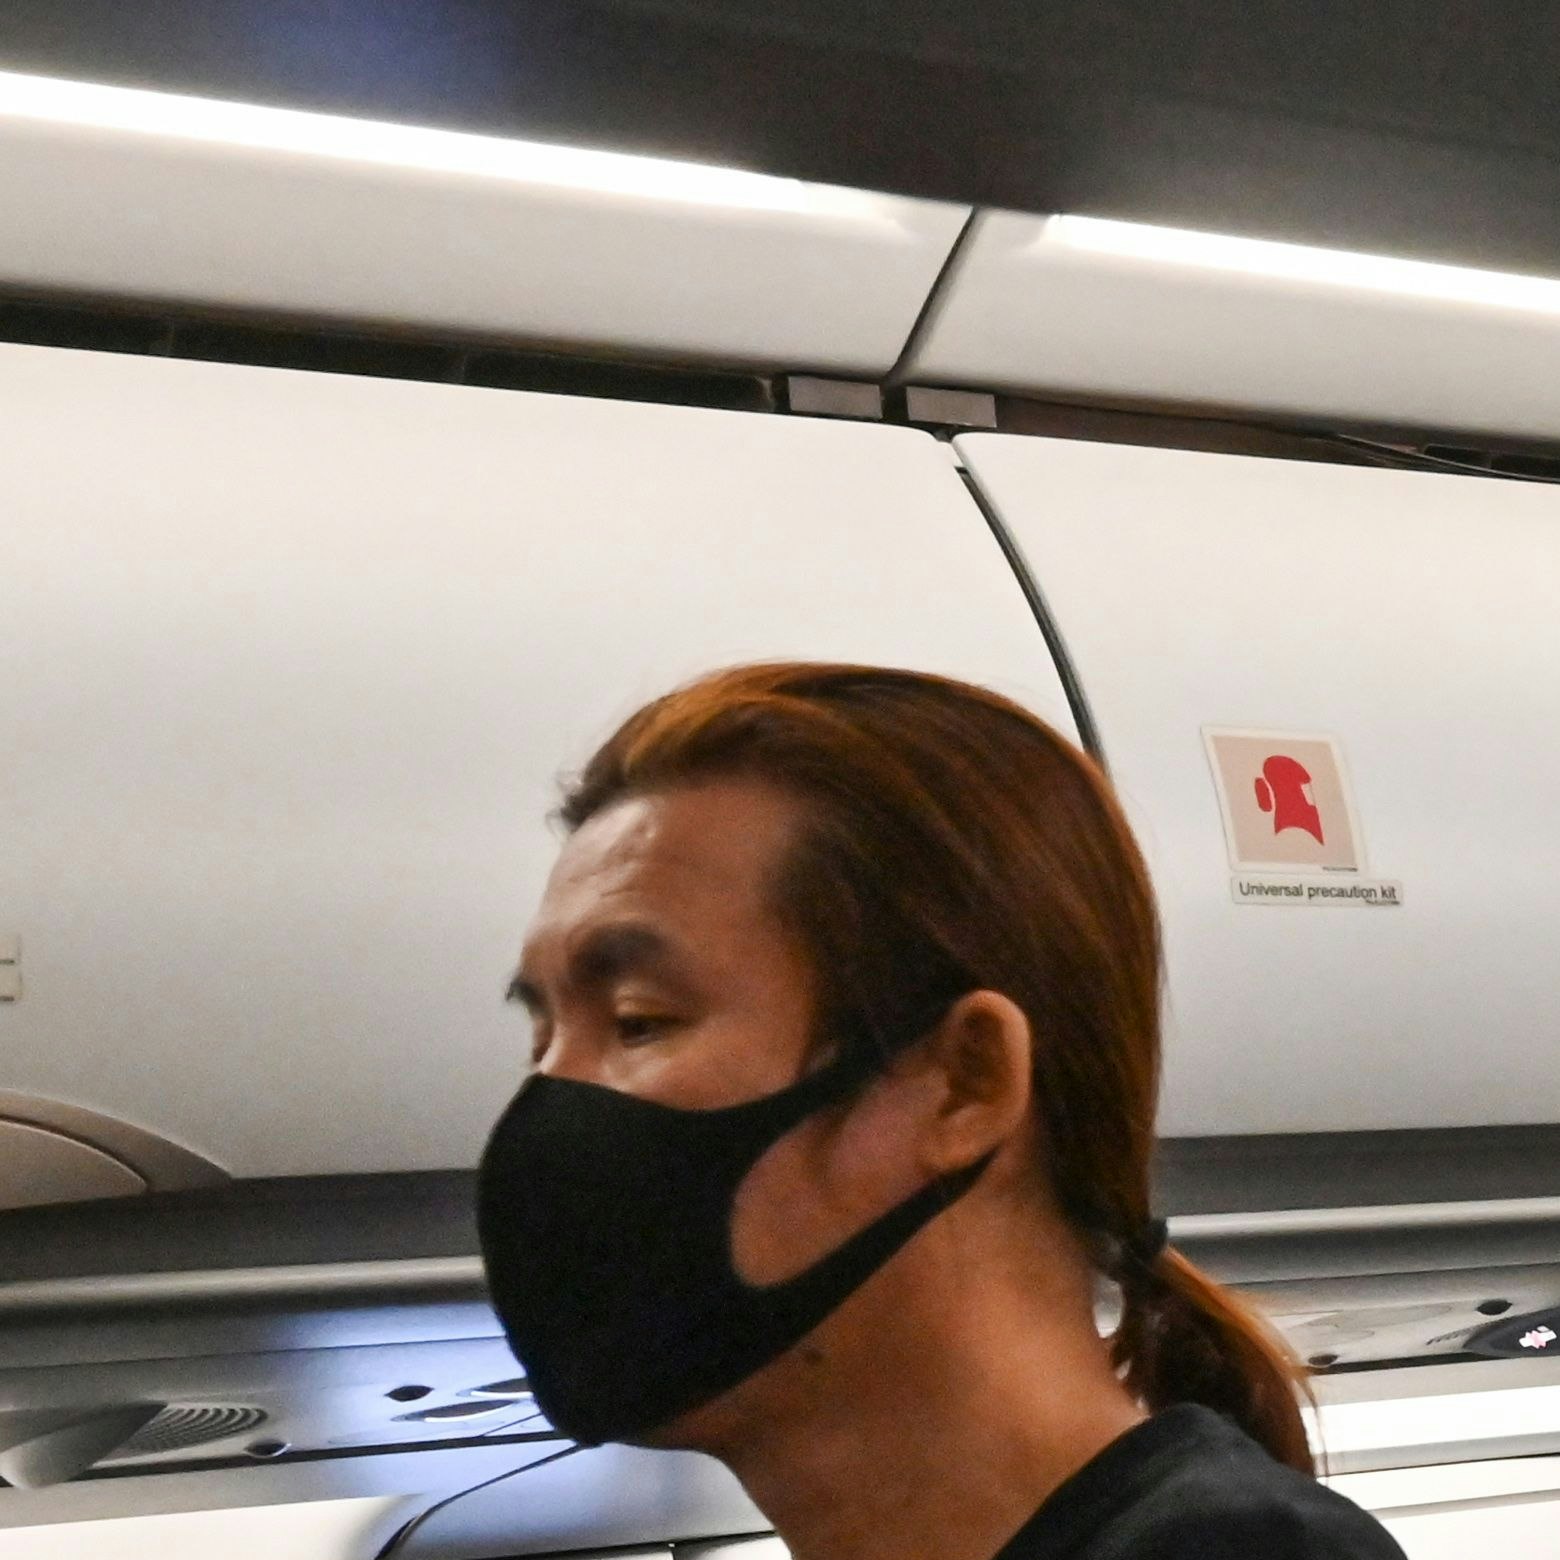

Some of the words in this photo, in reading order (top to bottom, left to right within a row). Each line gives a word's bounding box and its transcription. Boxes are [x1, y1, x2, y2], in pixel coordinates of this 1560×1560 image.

[1239, 881, 1304, 897] Universal
[1307, 884, 1377, 900] precaution
[1381, 886, 1397, 900] kit
